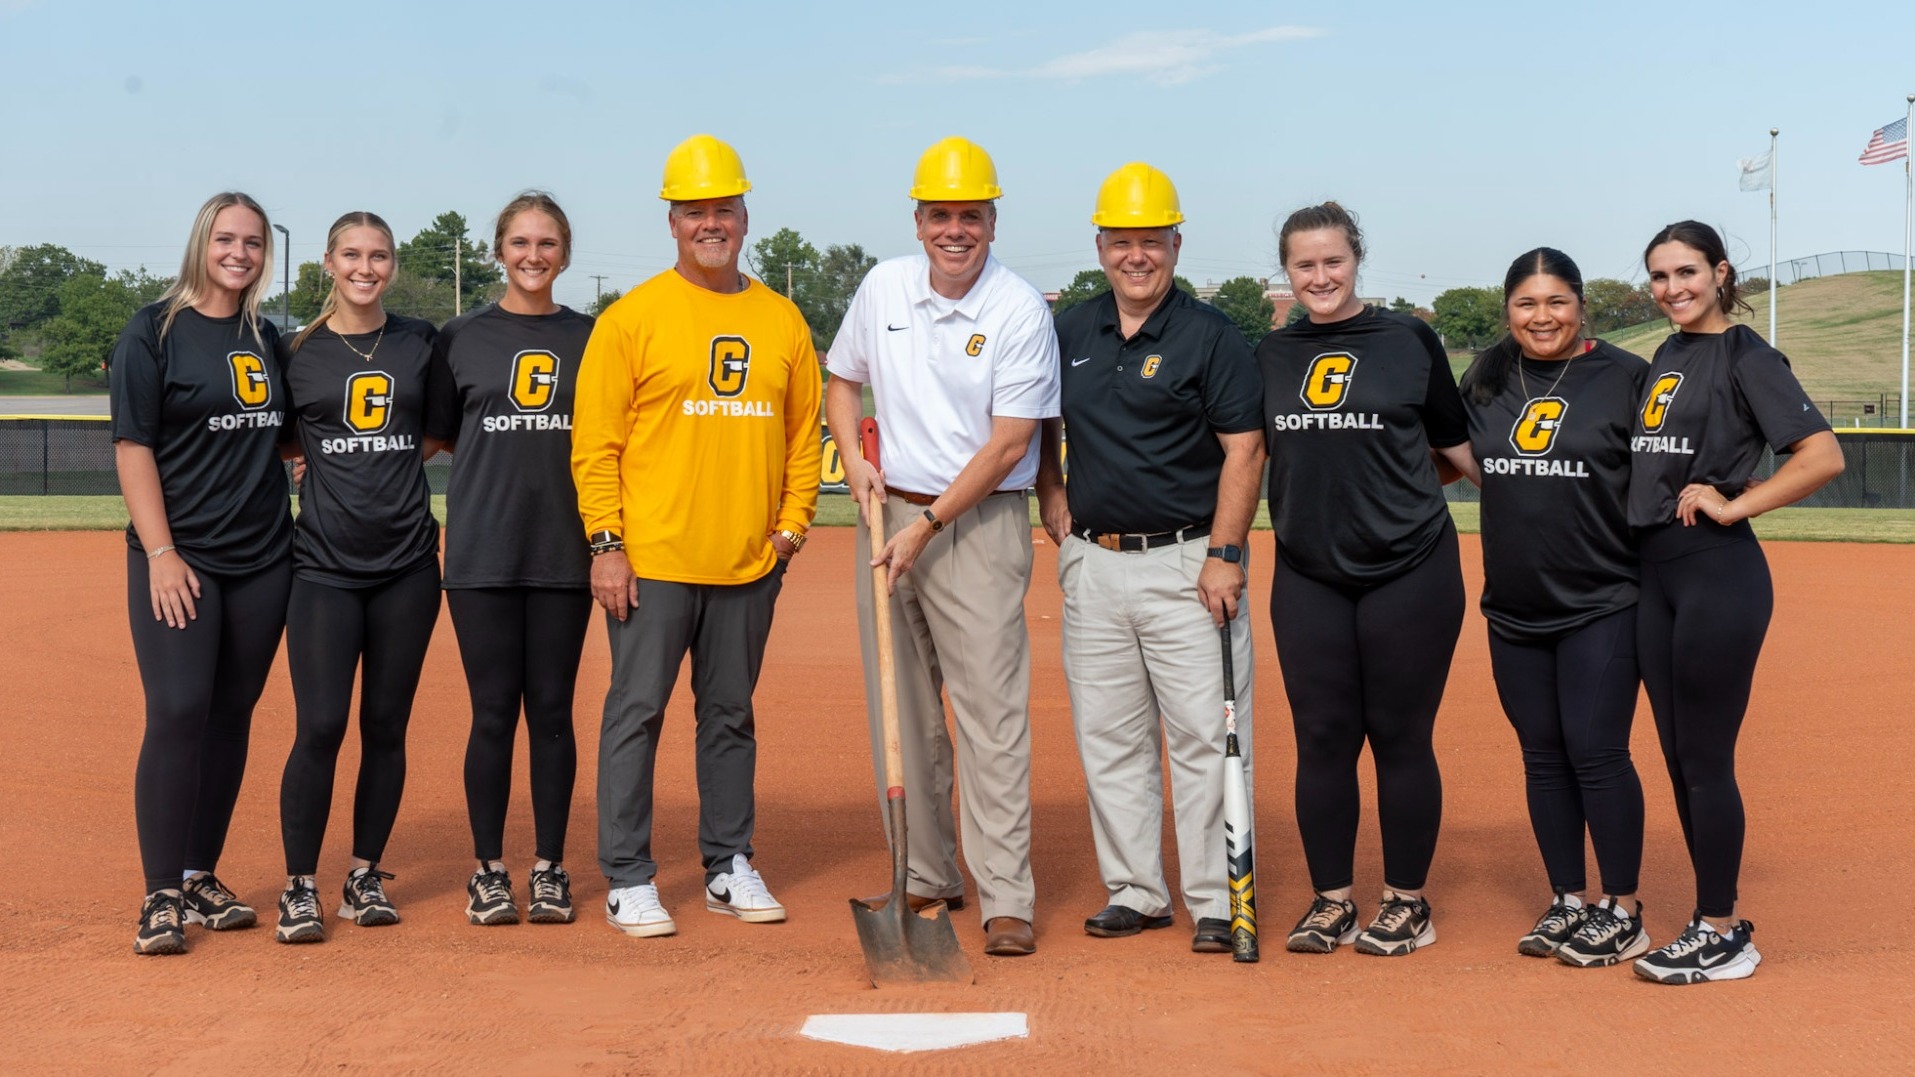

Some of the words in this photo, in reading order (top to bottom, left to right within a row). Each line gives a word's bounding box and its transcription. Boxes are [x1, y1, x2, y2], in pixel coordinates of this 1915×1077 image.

[682, 399, 775, 417] SOFTBALL
[482, 414, 572, 432] SOFTBAL
[1274, 412, 1384, 431] SOFTBALL
[321, 434, 415, 454] SOFTBALL
[1483, 457, 1590, 478] SOFTBALL
